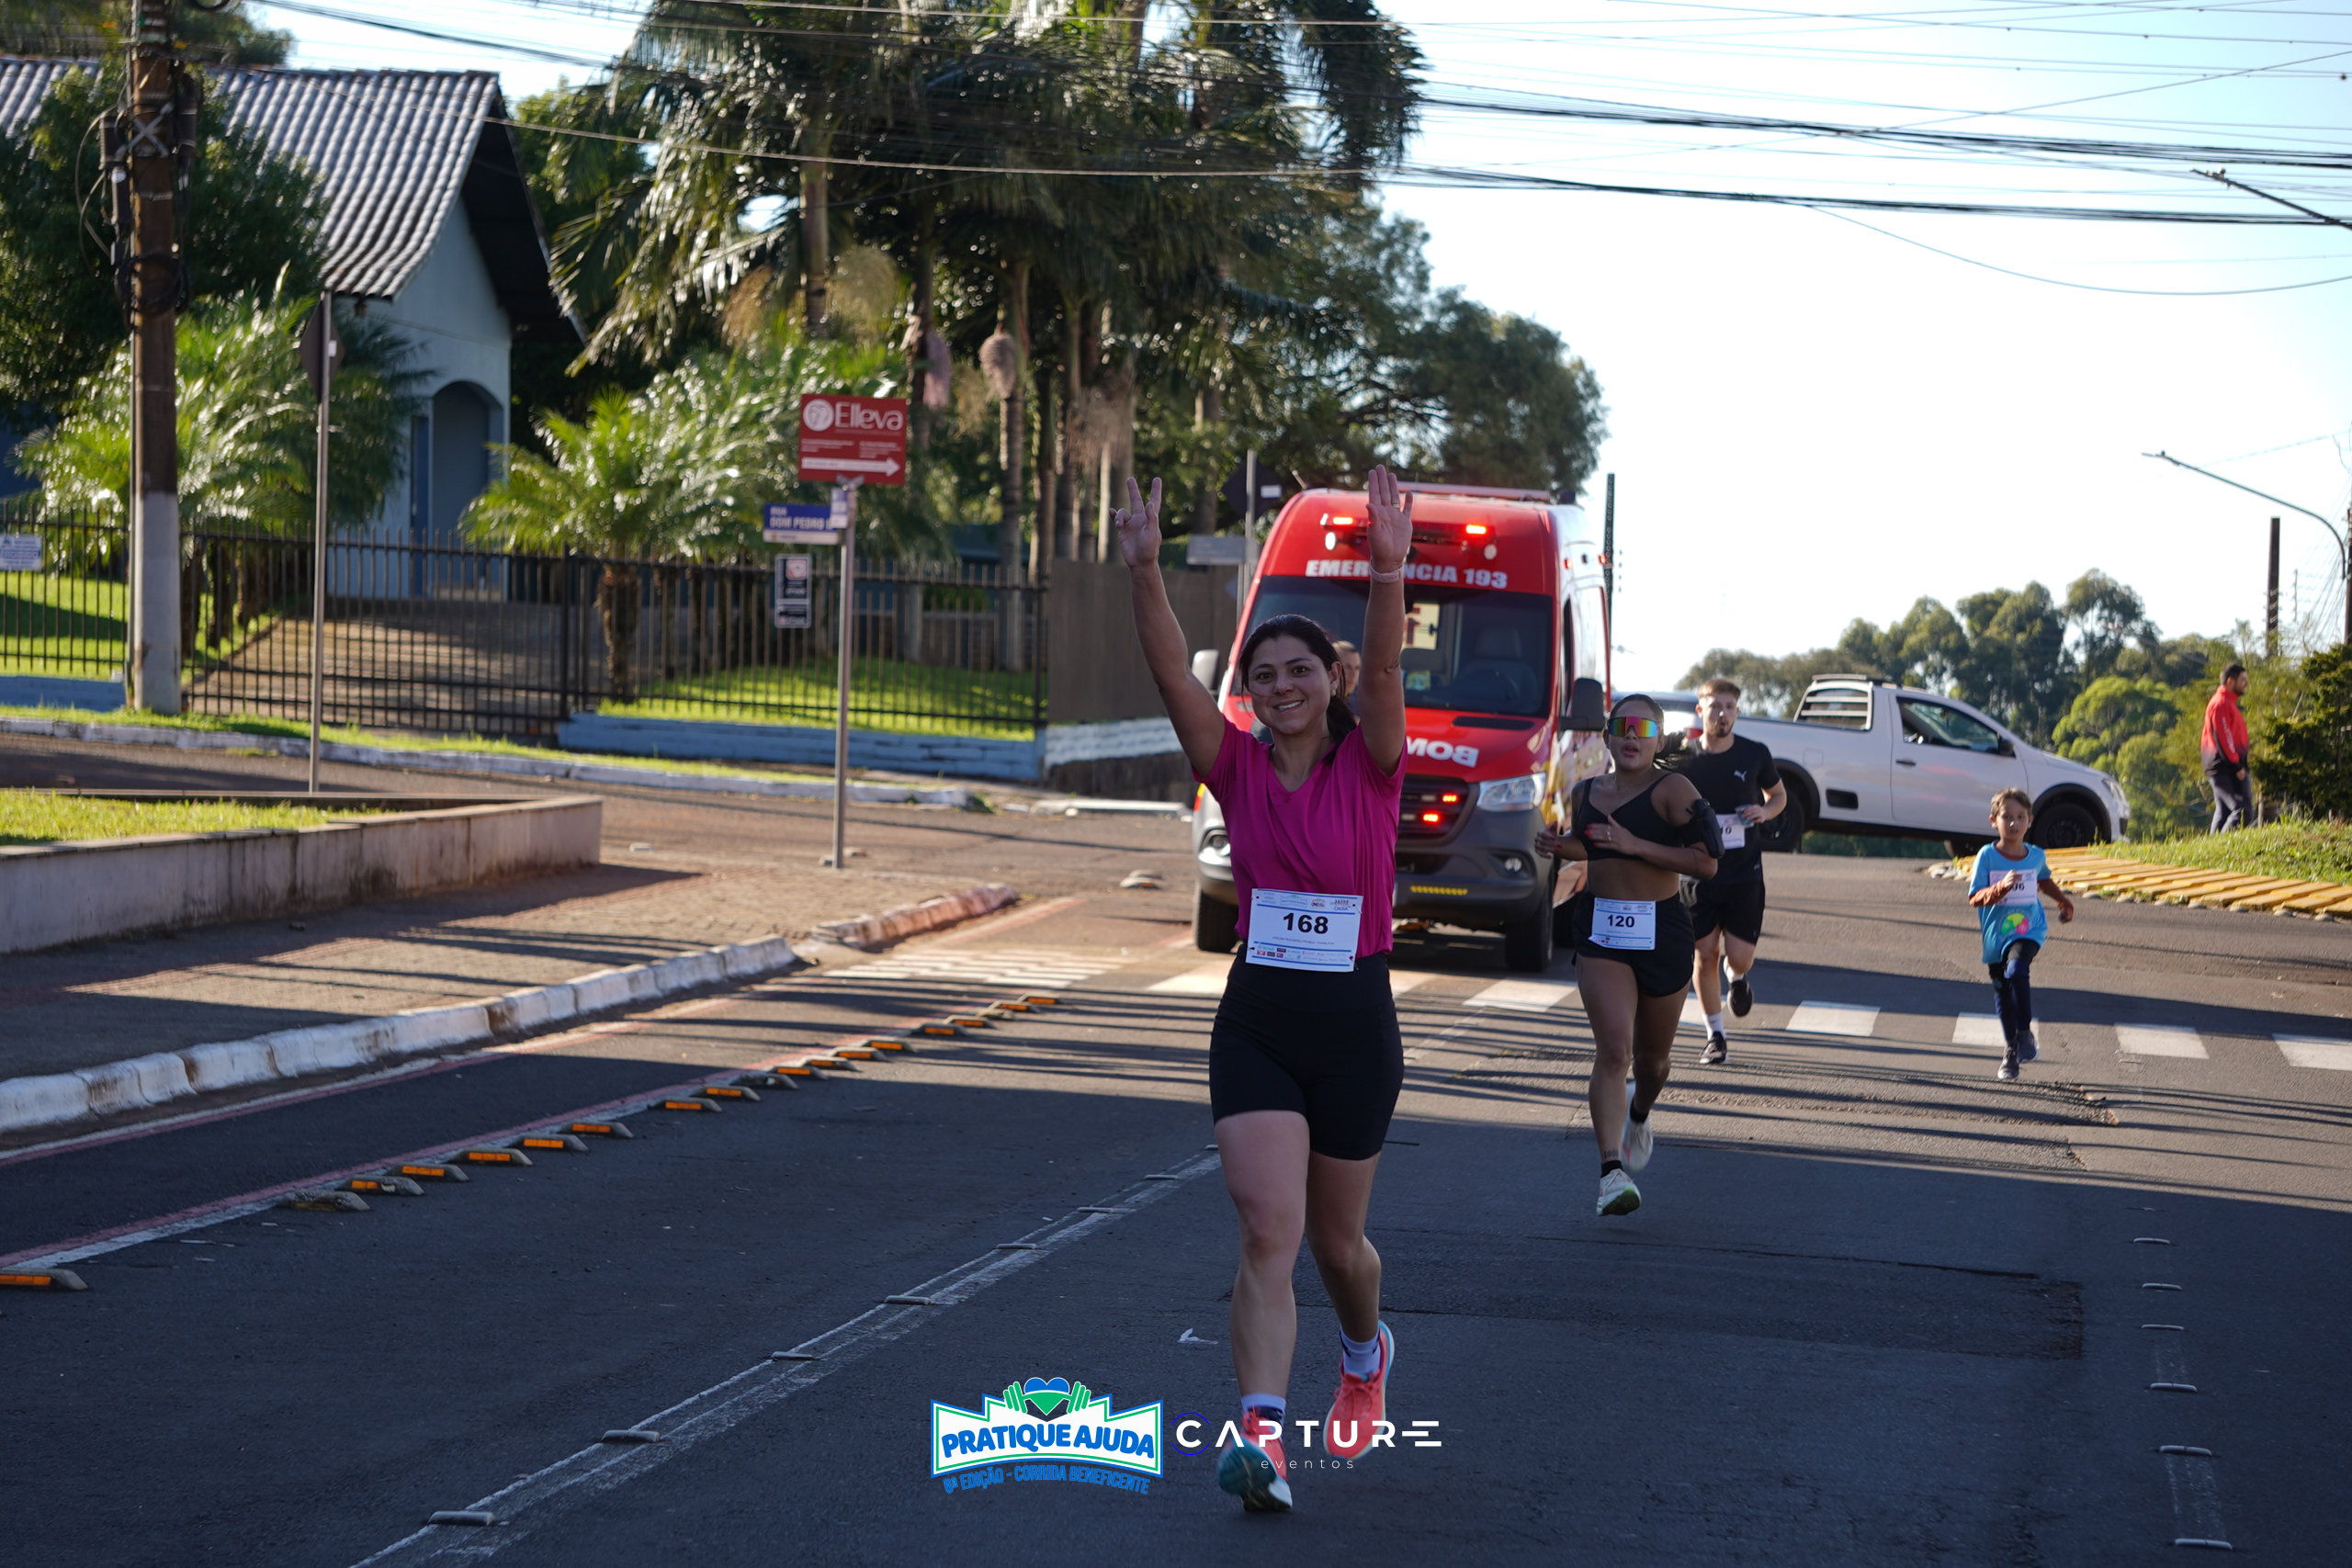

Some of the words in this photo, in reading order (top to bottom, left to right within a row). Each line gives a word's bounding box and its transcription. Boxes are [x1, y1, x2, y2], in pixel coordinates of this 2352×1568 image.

[835, 401, 904, 431] Elleva
[770, 506, 787, 517] RUA
[769, 516, 792, 529] DOM
[793, 516, 825, 530] PEDRO
[1305, 559, 1458, 583] EMERNCIA
[1463, 568, 1508, 590] 193
[1283, 912, 1329, 934] 168
[1607, 914, 1635, 928] 120
